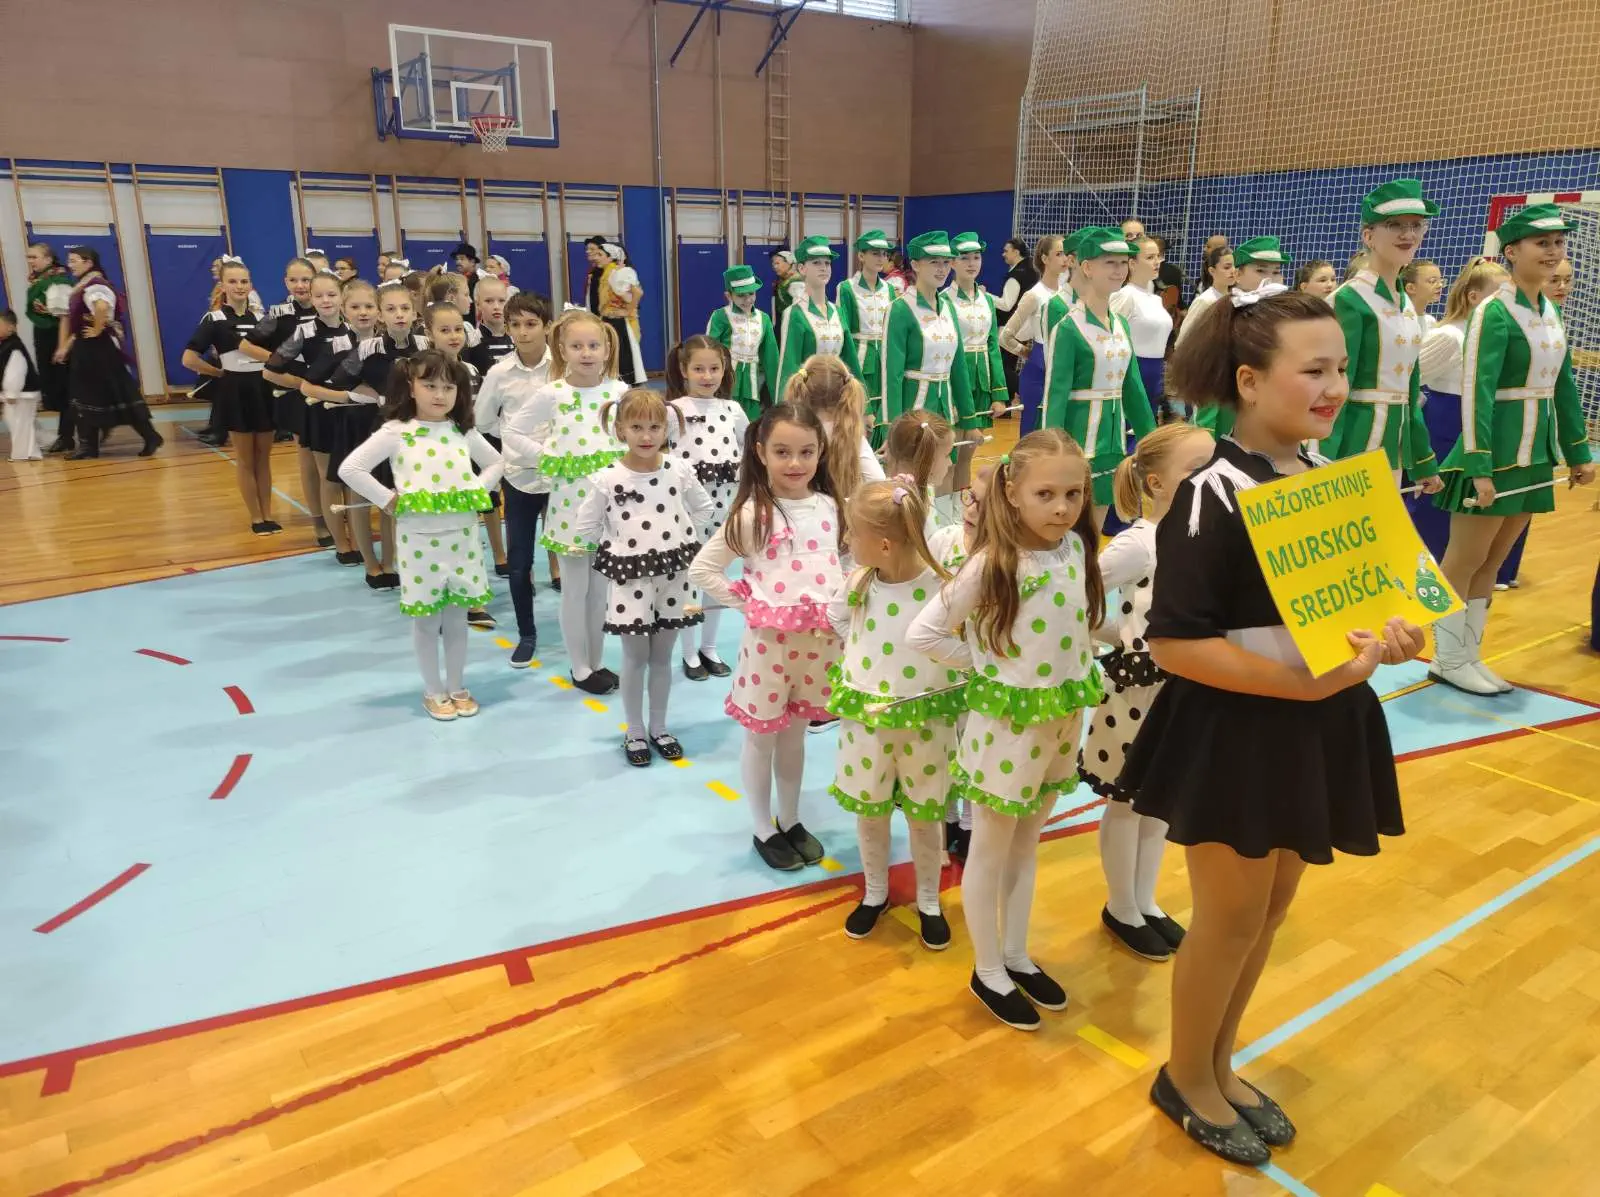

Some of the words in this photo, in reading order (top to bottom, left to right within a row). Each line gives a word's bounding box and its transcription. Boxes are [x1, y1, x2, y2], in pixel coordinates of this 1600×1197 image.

[1246, 469, 1373, 527] MAŽORETKINJE
[1266, 515, 1377, 578] MURSKOG
[1290, 561, 1394, 627] SREDIŠĆA
